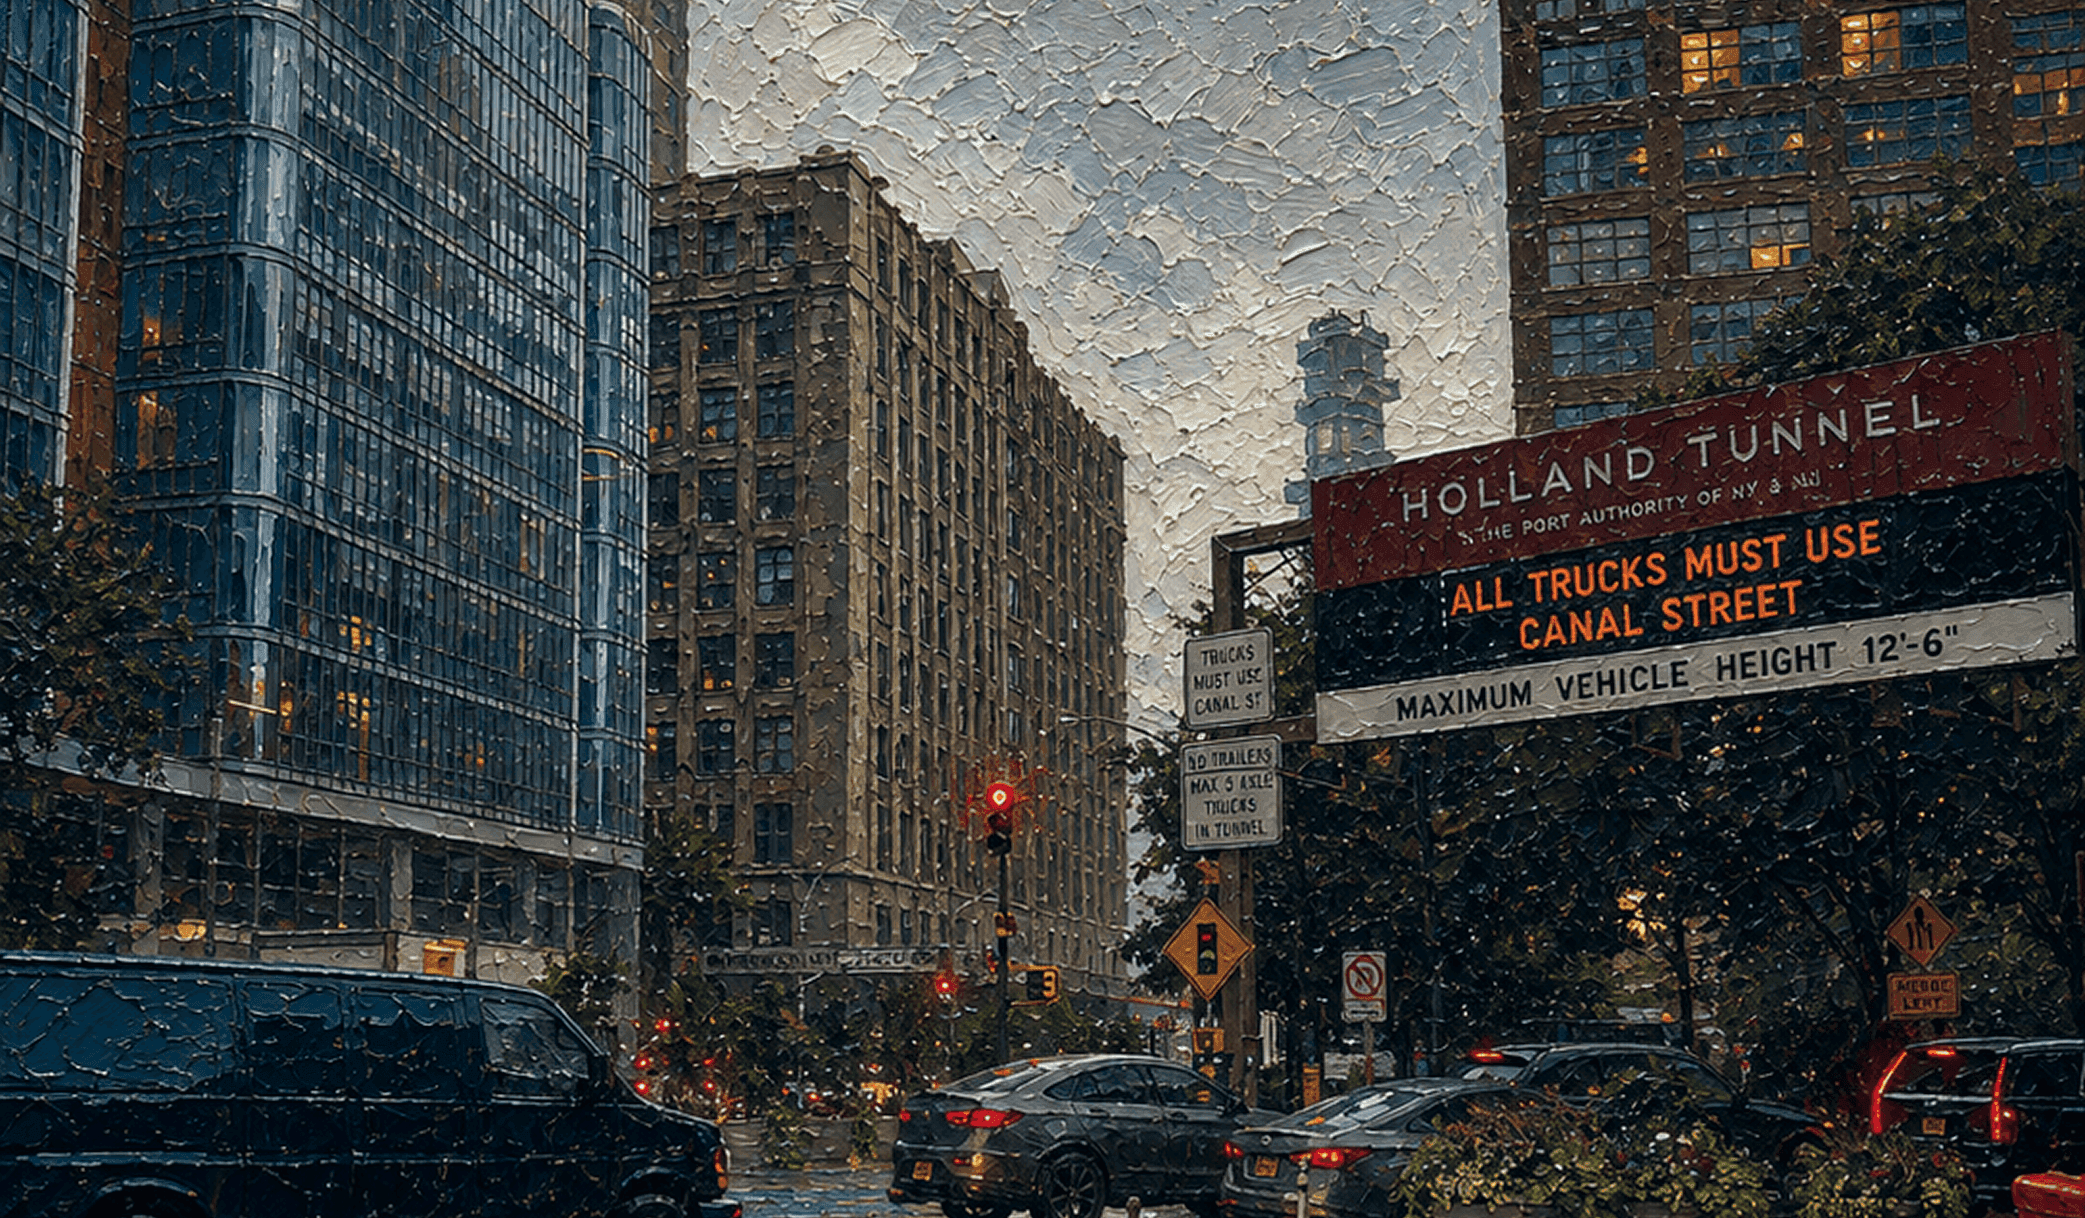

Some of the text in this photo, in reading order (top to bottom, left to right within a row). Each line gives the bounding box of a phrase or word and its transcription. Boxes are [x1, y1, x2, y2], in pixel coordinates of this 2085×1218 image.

[1402, 394, 1941, 522] HOLLAND TUNNEL
[1521, 513, 1571, 535] PORT
[1579, 494, 1688, 526] AUTHORITY
[1697, 487, 1722, 507] OF
[1732, 480, 1758, 500] NY
[1450, 519, 1882, 616] ALL TRUCKS MUST USE
[1519, 579, 1802, 650] CANAL STREET
[1194, 671, 1231, 689] MUST
[1201, 644, 1254, 666] TRUCKS
[1396, 625, 1959, 721] MAXIMUM VEHICLE HEIGHT 12'-6"
[1195, 691, 1262, 715] CANAL ST
